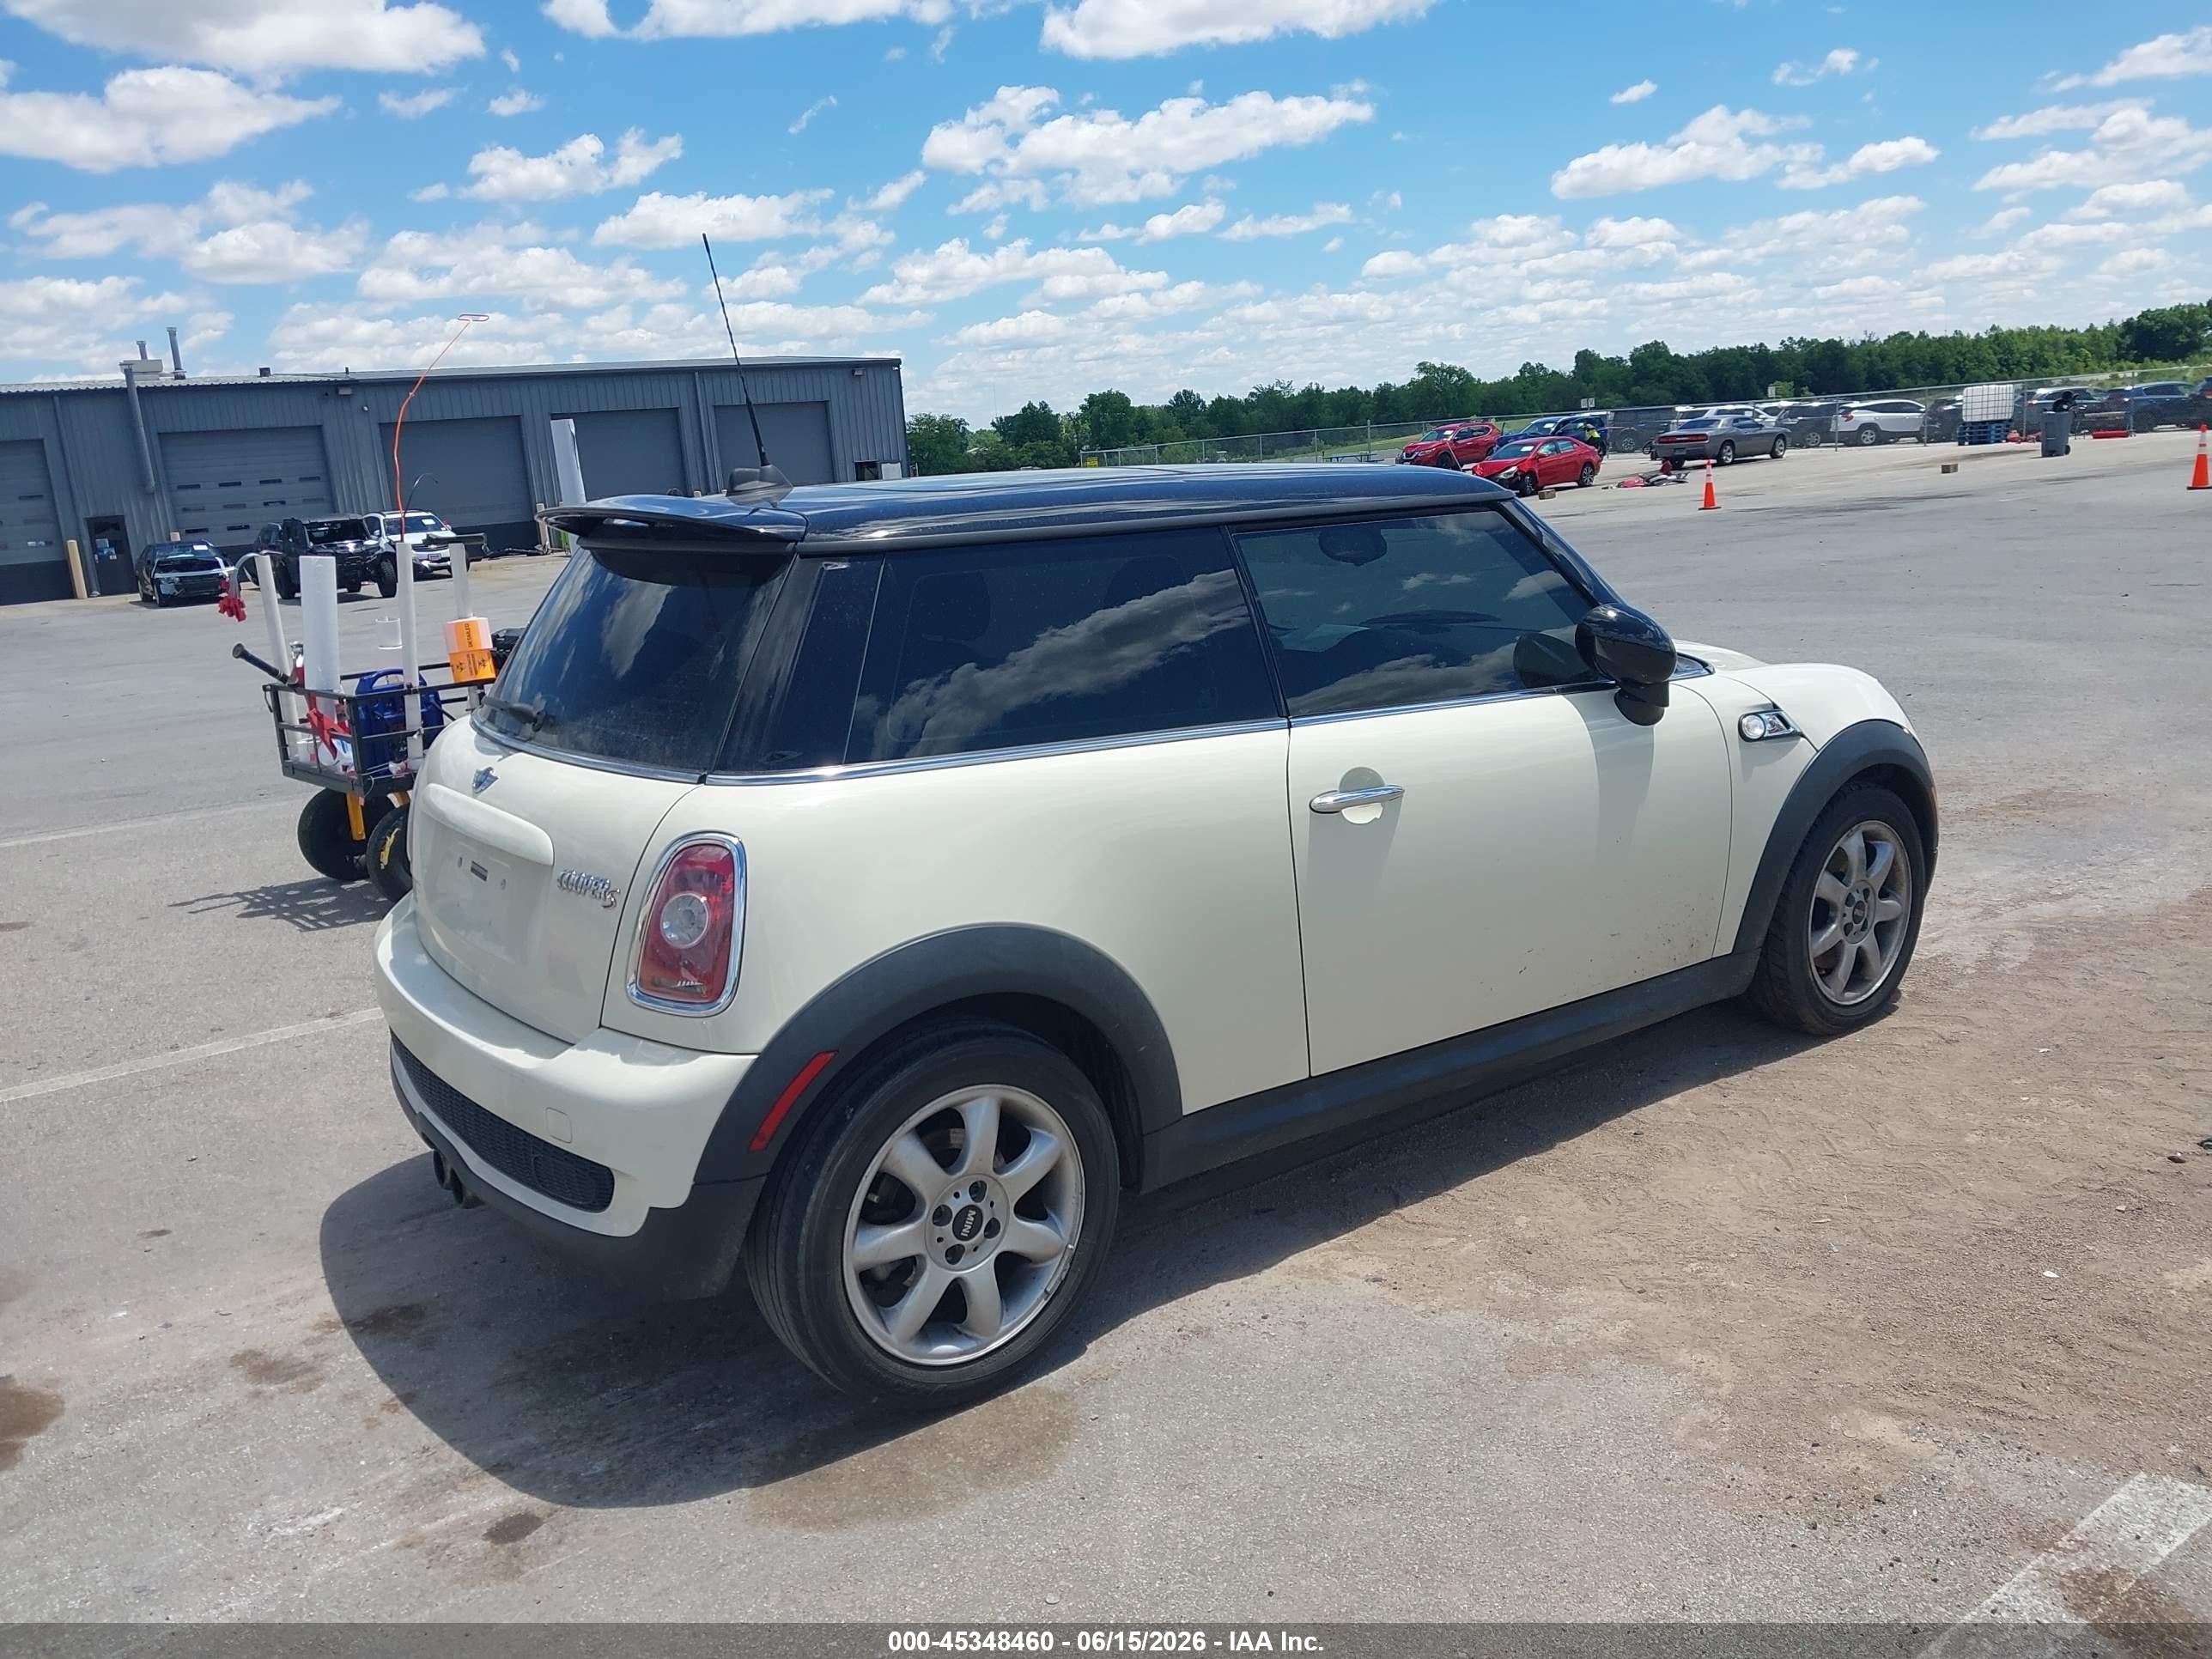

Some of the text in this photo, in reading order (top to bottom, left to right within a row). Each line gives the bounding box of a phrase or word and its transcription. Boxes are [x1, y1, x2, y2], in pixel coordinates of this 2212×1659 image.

[556, 869, 621, 908] COOPER S
[960, 1209, 977, 1237] MINI
